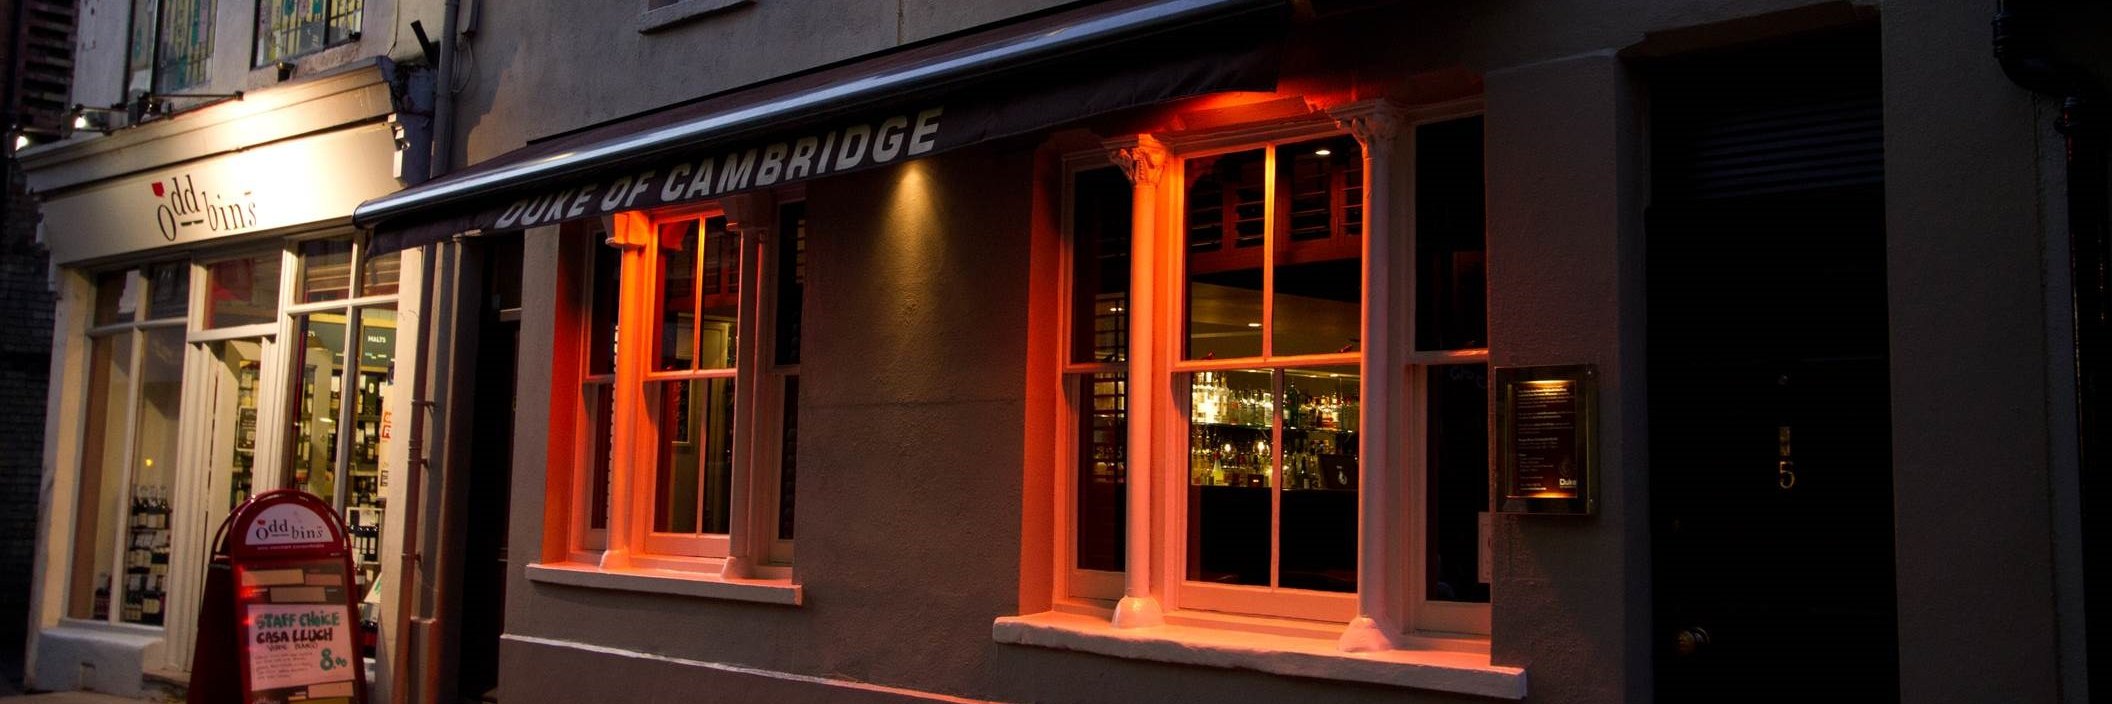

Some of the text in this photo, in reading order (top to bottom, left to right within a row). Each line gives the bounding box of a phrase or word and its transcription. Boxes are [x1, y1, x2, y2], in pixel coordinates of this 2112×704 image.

[494, 105, 945, 229] DUKE OF CAMBRIDGE
[255, 613, 297, 629] STAFF
[256, 627, 334, 645] CASA LLUCH
